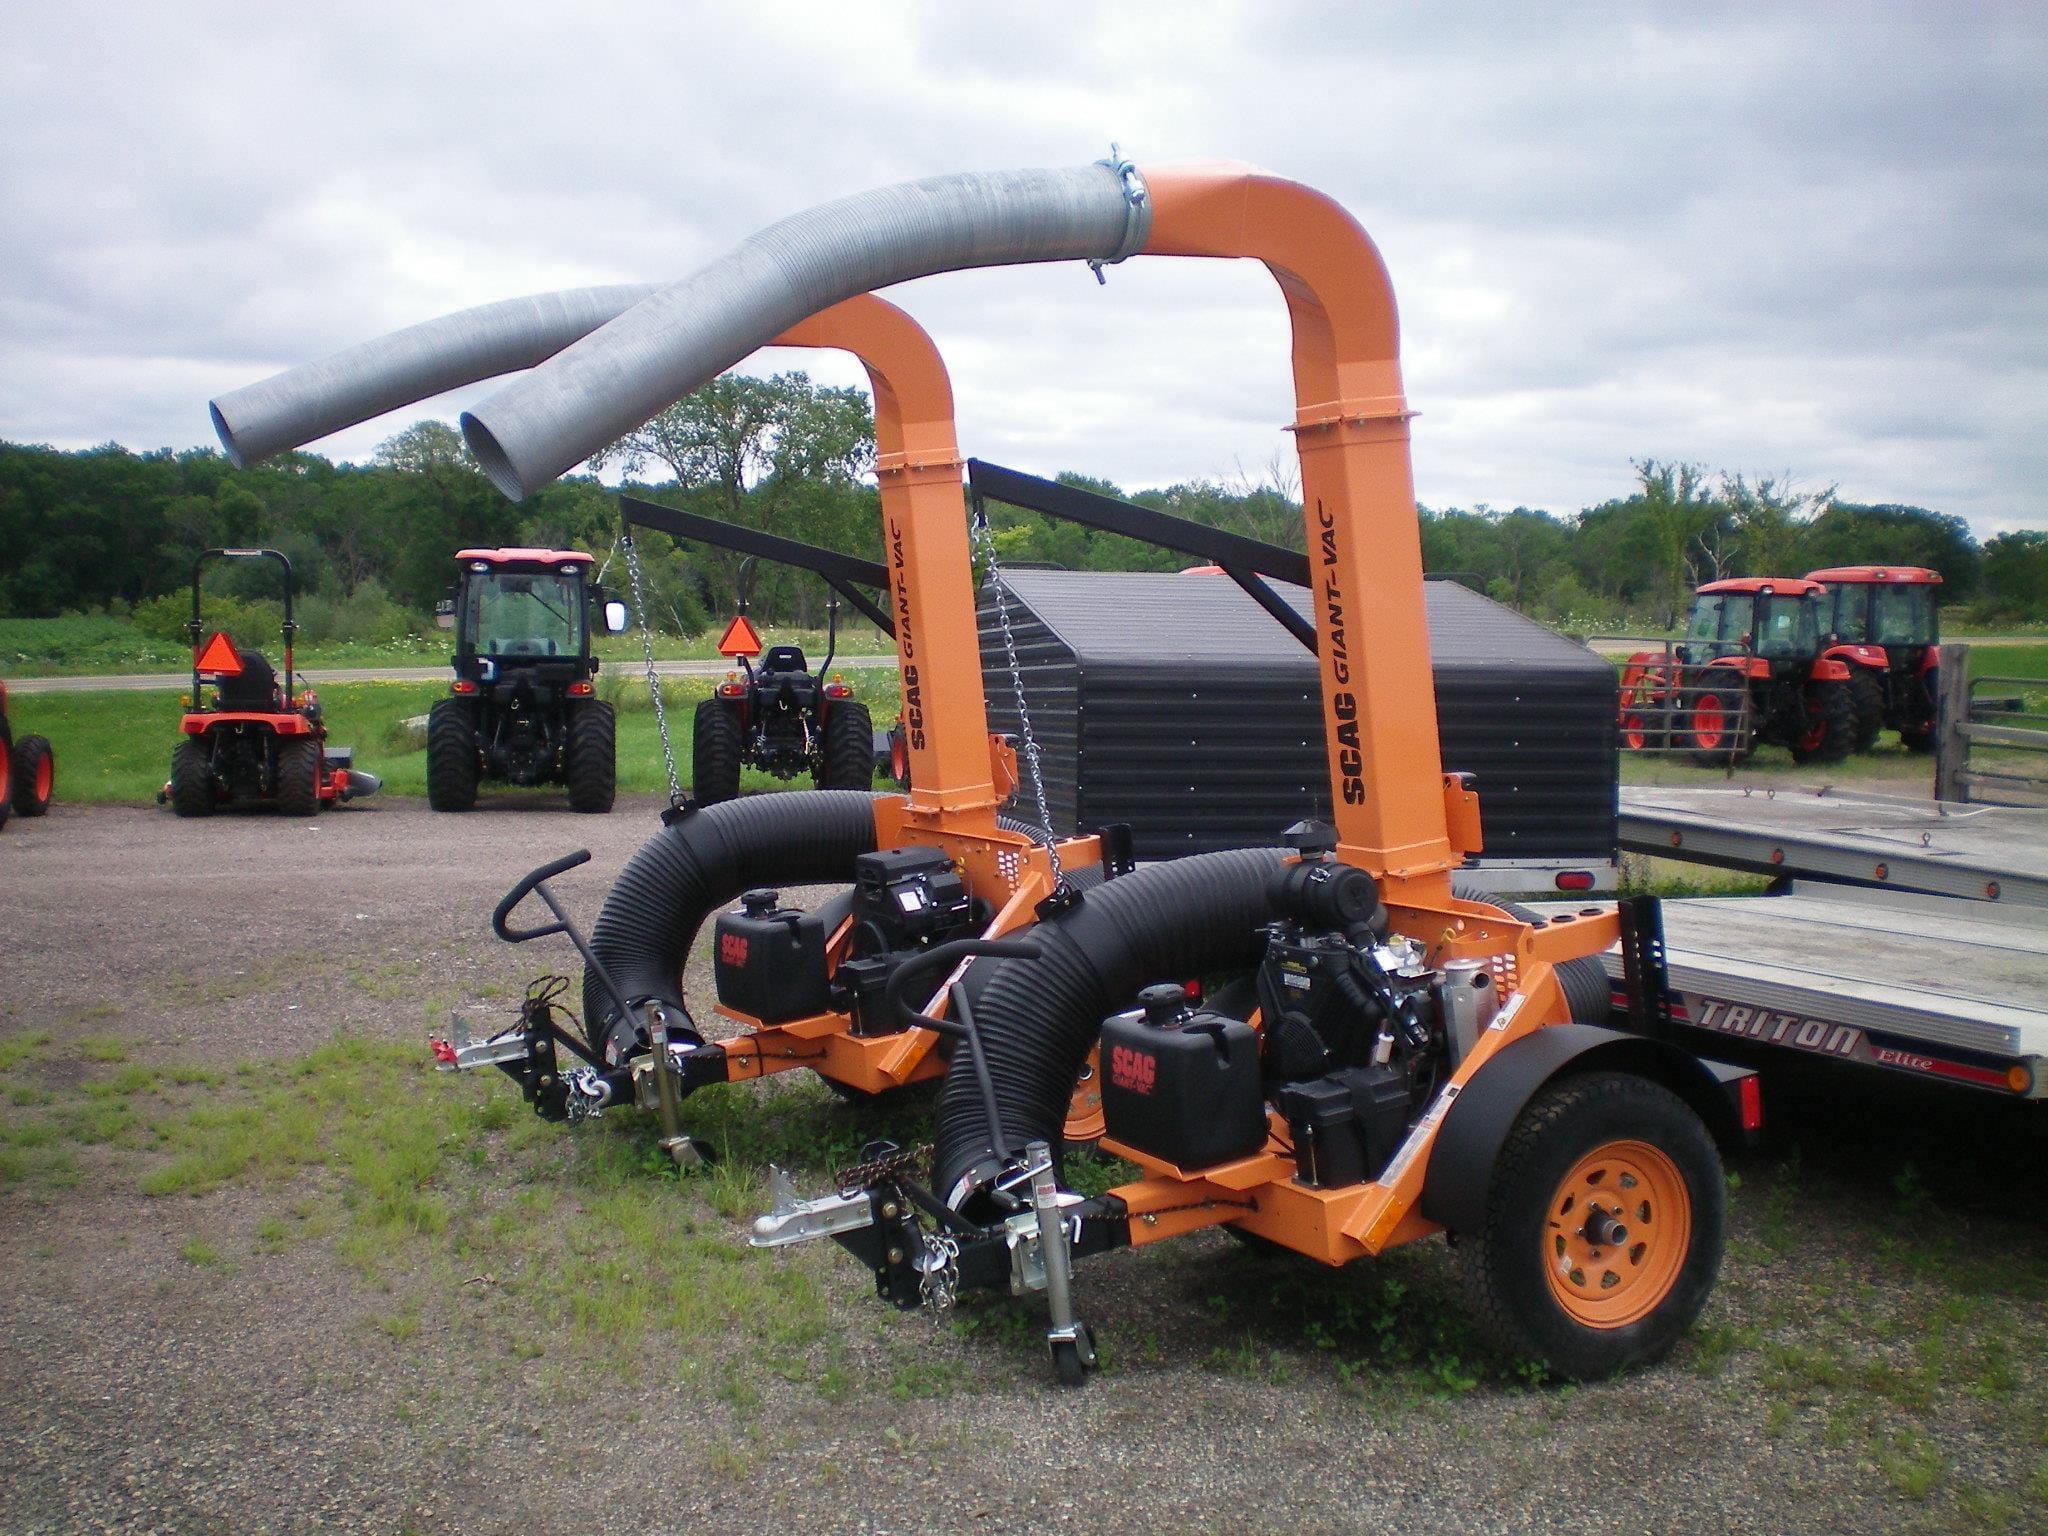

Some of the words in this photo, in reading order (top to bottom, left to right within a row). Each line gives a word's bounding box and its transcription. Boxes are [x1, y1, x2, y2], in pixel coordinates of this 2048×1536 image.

[904, 665, 925, 750] SCAG
[1334, 692, 1365, 805] SCAG
[1112, 1045, 1156, 1085] SCAG
[1698, 1000, 1864, 1057] TRITON
[1878, 1049, 1934, 1070] Elite
